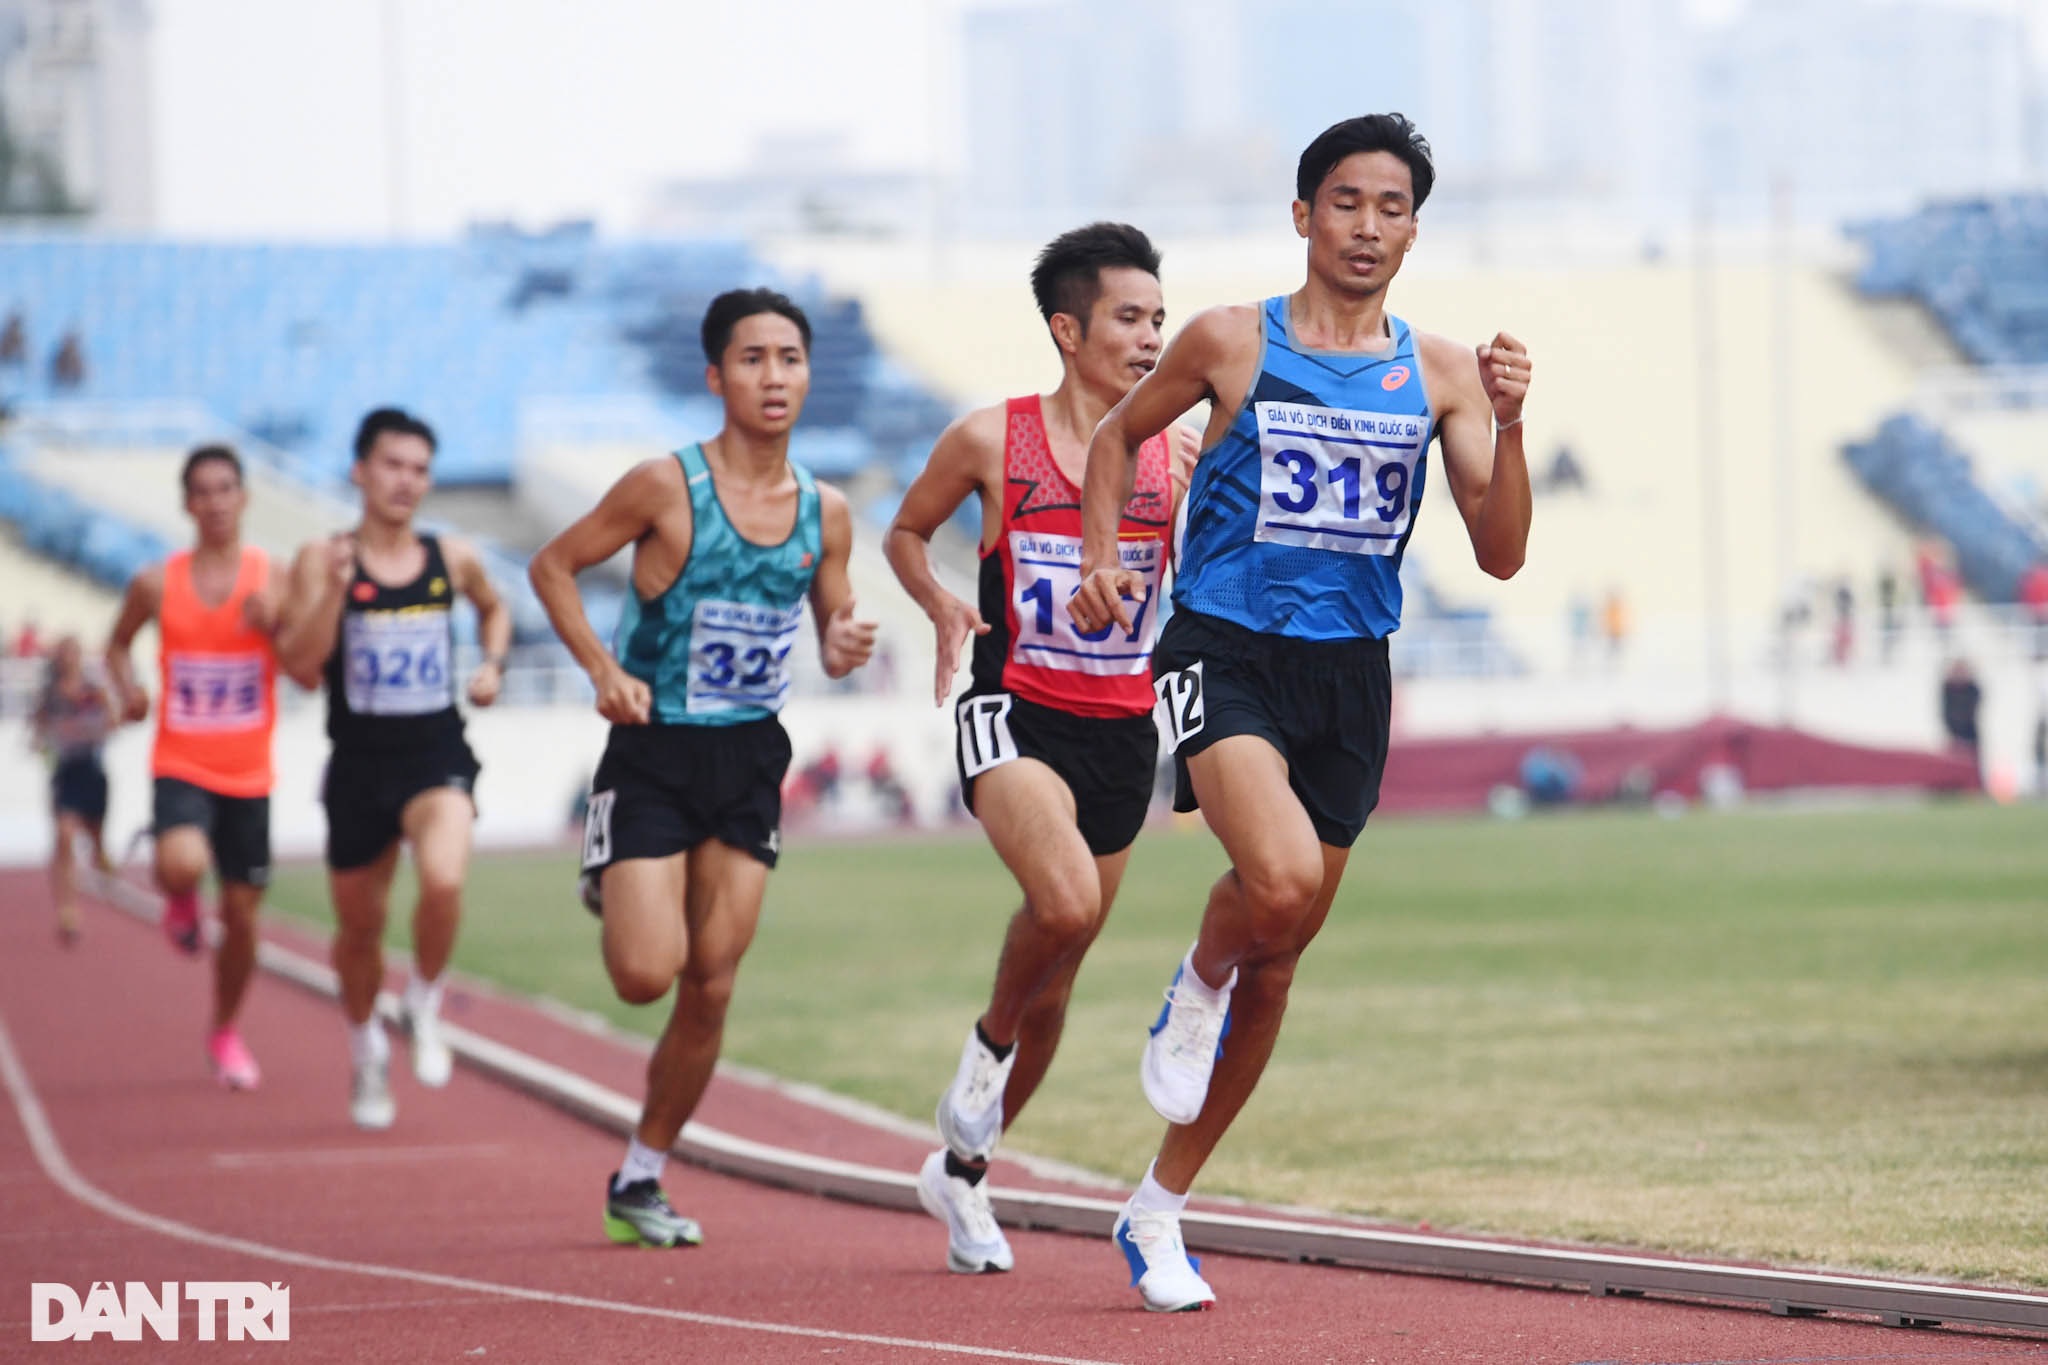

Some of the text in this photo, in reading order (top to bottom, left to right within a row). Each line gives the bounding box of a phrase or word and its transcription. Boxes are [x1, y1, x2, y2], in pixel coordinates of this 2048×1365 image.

[1354, 418, 1376, 433] KINH
[1405, 423, 1418, 436] GIA
[1272, 449, 1408, 522] 319
[964, 702, 1003, 766] 17
[1161, 670, 1202, 742] 12
